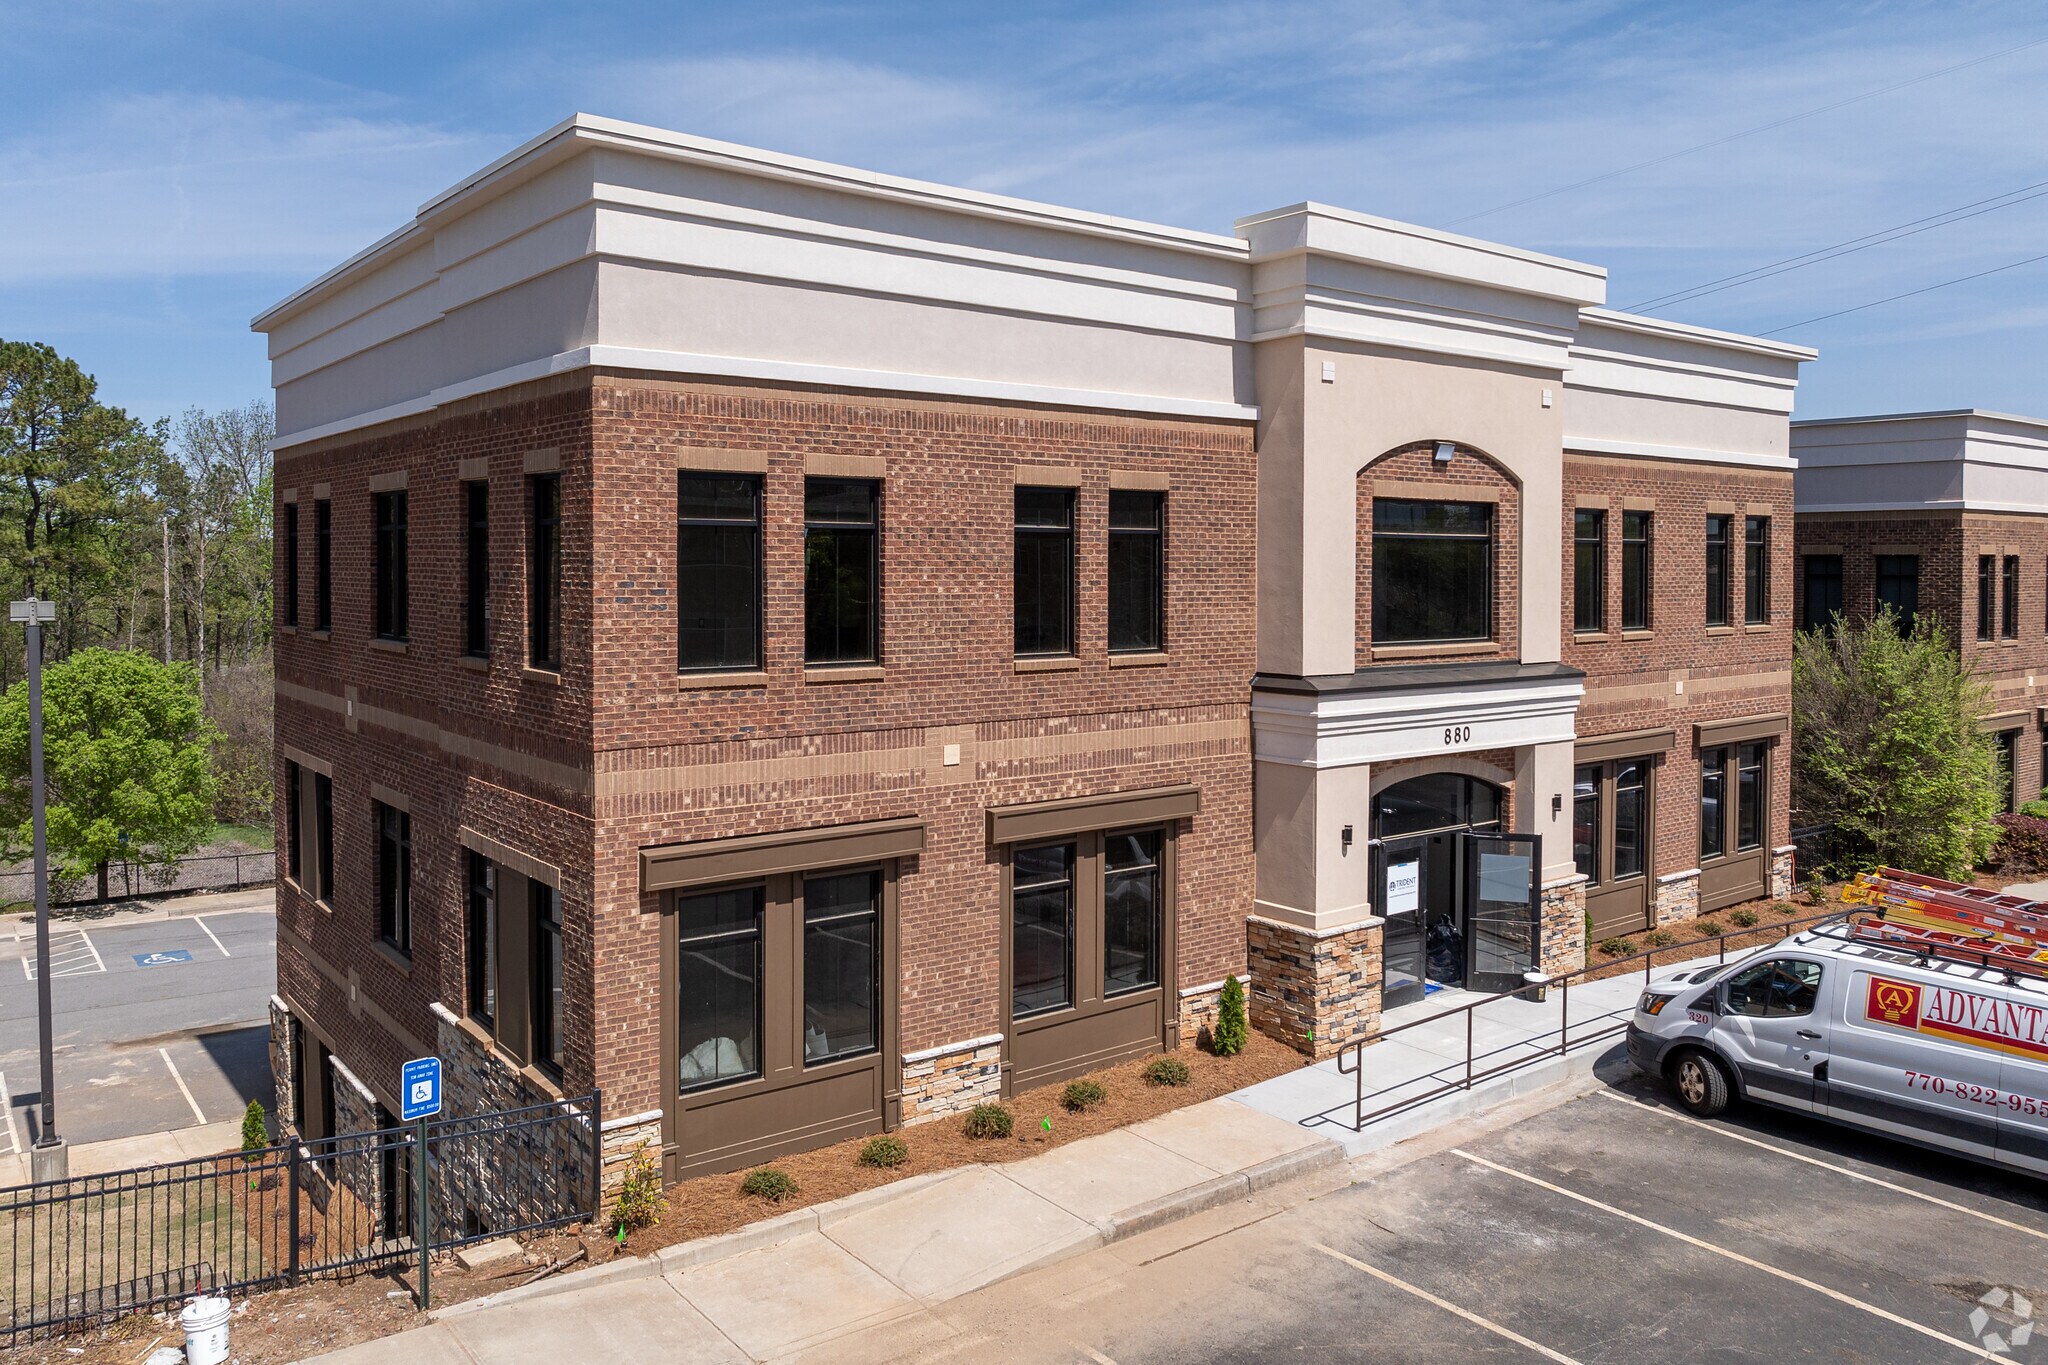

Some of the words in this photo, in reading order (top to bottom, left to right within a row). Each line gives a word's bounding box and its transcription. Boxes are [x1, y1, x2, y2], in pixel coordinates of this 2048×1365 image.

[1444, 726, 1470, 745] 880
[1396, 876, 1417, 887] TRIDENT
[1884, 990, 1904, 1007] A
[1688, 1011, 1709, 1025] 320
[1904, 1070, 2048, 1119] 770-822-955
